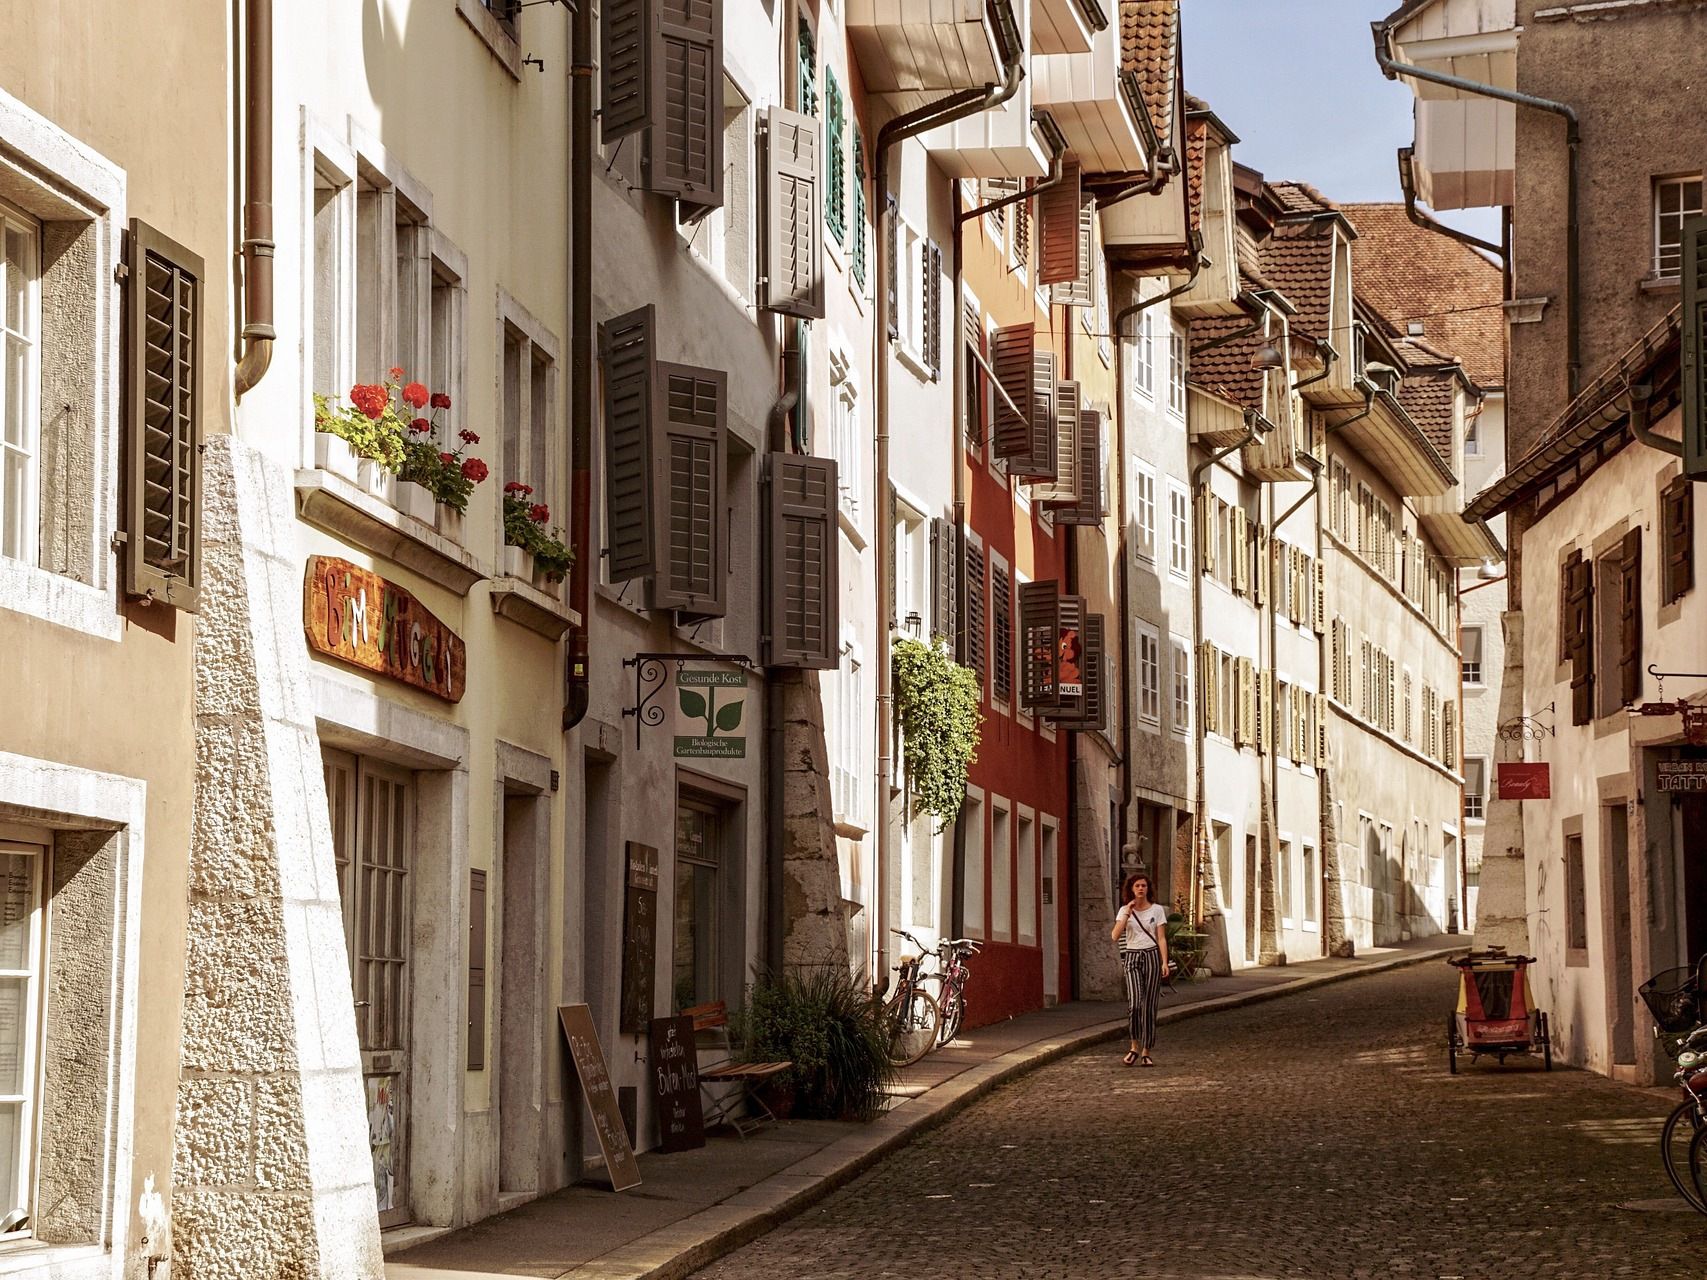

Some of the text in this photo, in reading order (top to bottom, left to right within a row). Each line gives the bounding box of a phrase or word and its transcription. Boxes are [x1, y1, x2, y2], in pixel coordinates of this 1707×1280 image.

[680, 672, 742, 683] Gesunde Kost
[691, 738, 728, 747] Biologische
[676, 746, 742, 756] Gartenbauprodukte
